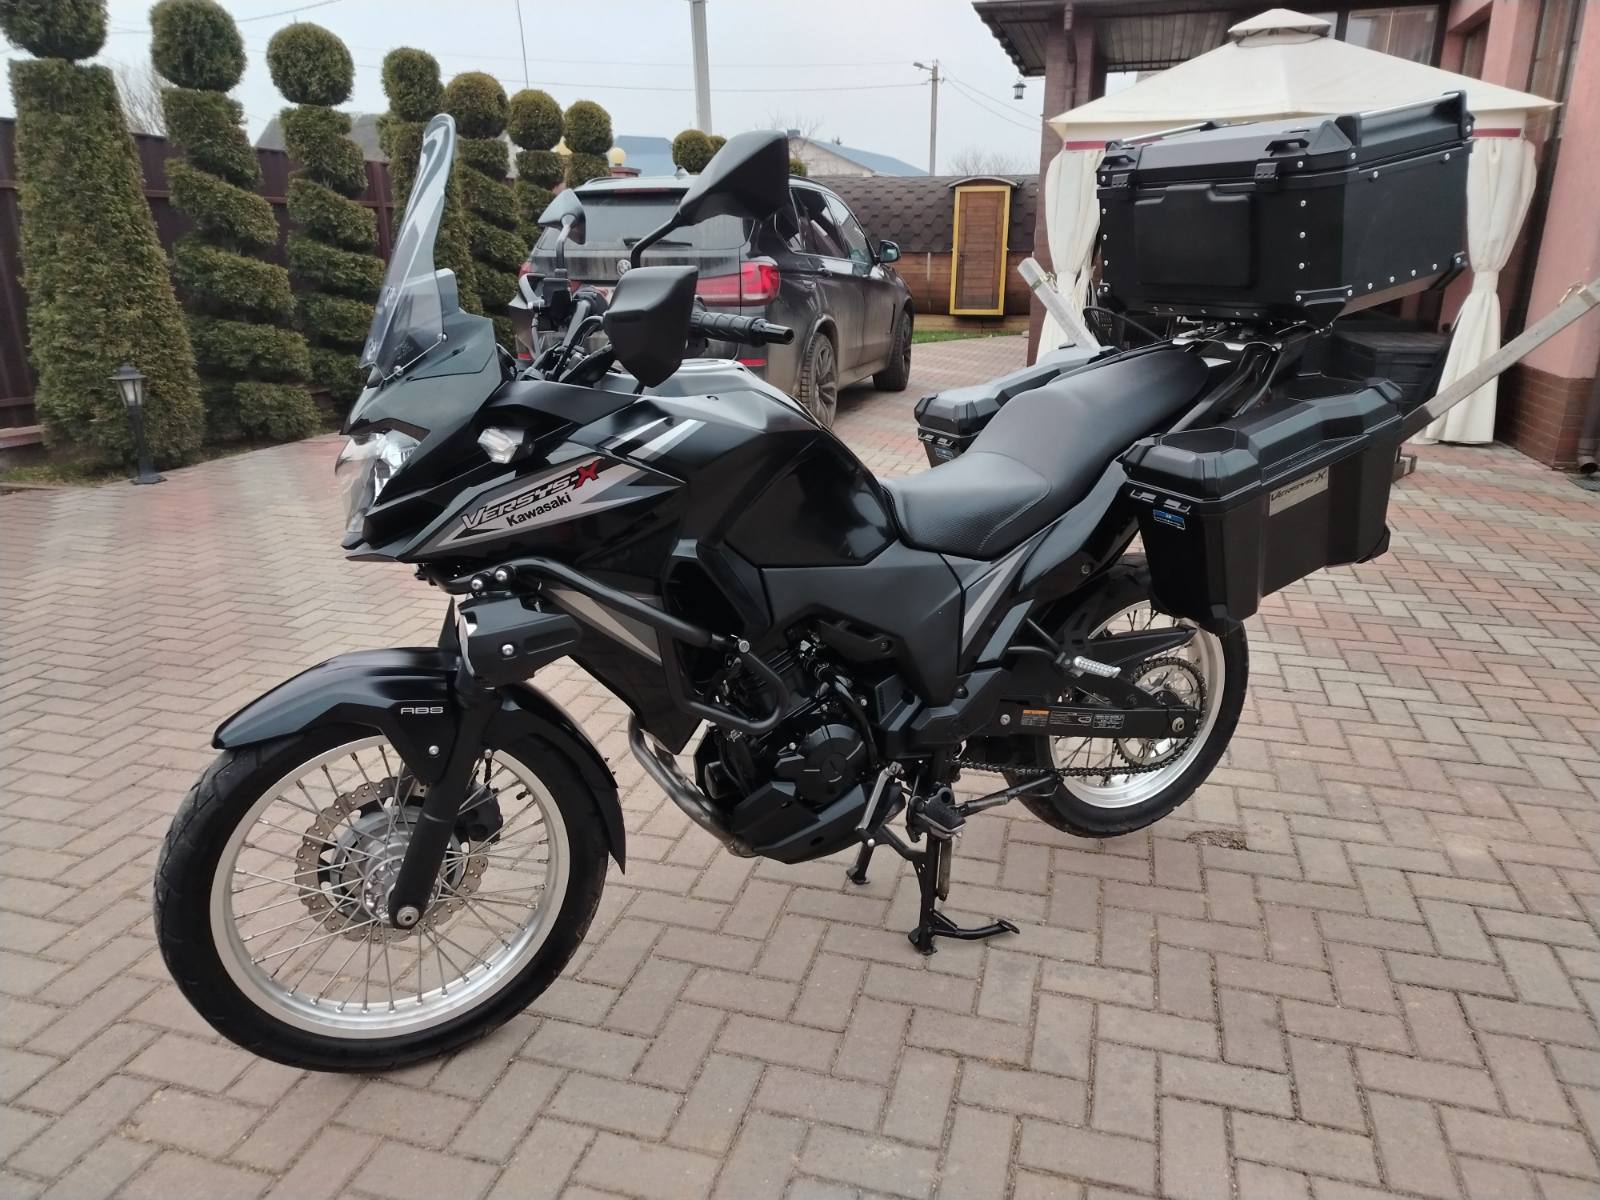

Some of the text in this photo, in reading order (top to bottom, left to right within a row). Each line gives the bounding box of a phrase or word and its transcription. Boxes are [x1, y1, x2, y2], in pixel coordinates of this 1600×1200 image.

[461, 460, 600, 529] VERSYS-X
[506, 492, 572, 527] Kawasaki
[400, 706, 444, 715] ABS
